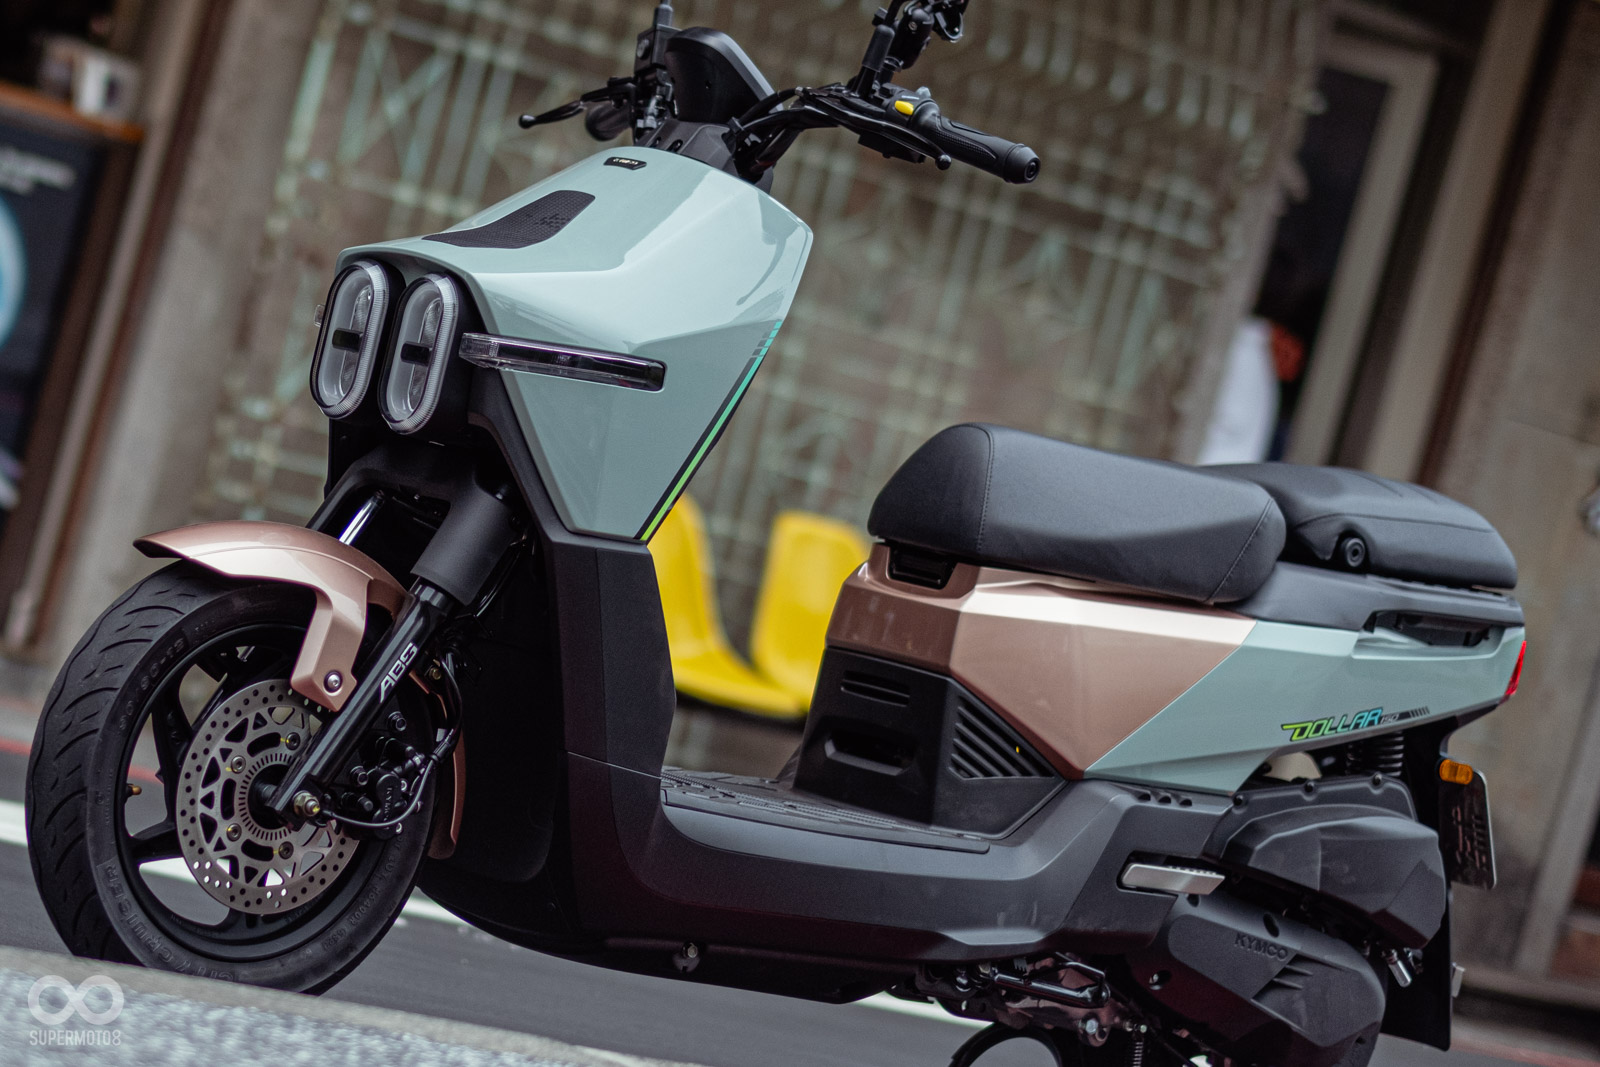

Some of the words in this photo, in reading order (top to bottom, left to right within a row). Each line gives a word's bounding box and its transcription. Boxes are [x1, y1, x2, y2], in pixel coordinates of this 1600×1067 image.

[380, 642, 418, 703] ABS
[1281, 707, 1383, 741] DOLLAR
[1234, 932, 1288, 961] KYMCO
